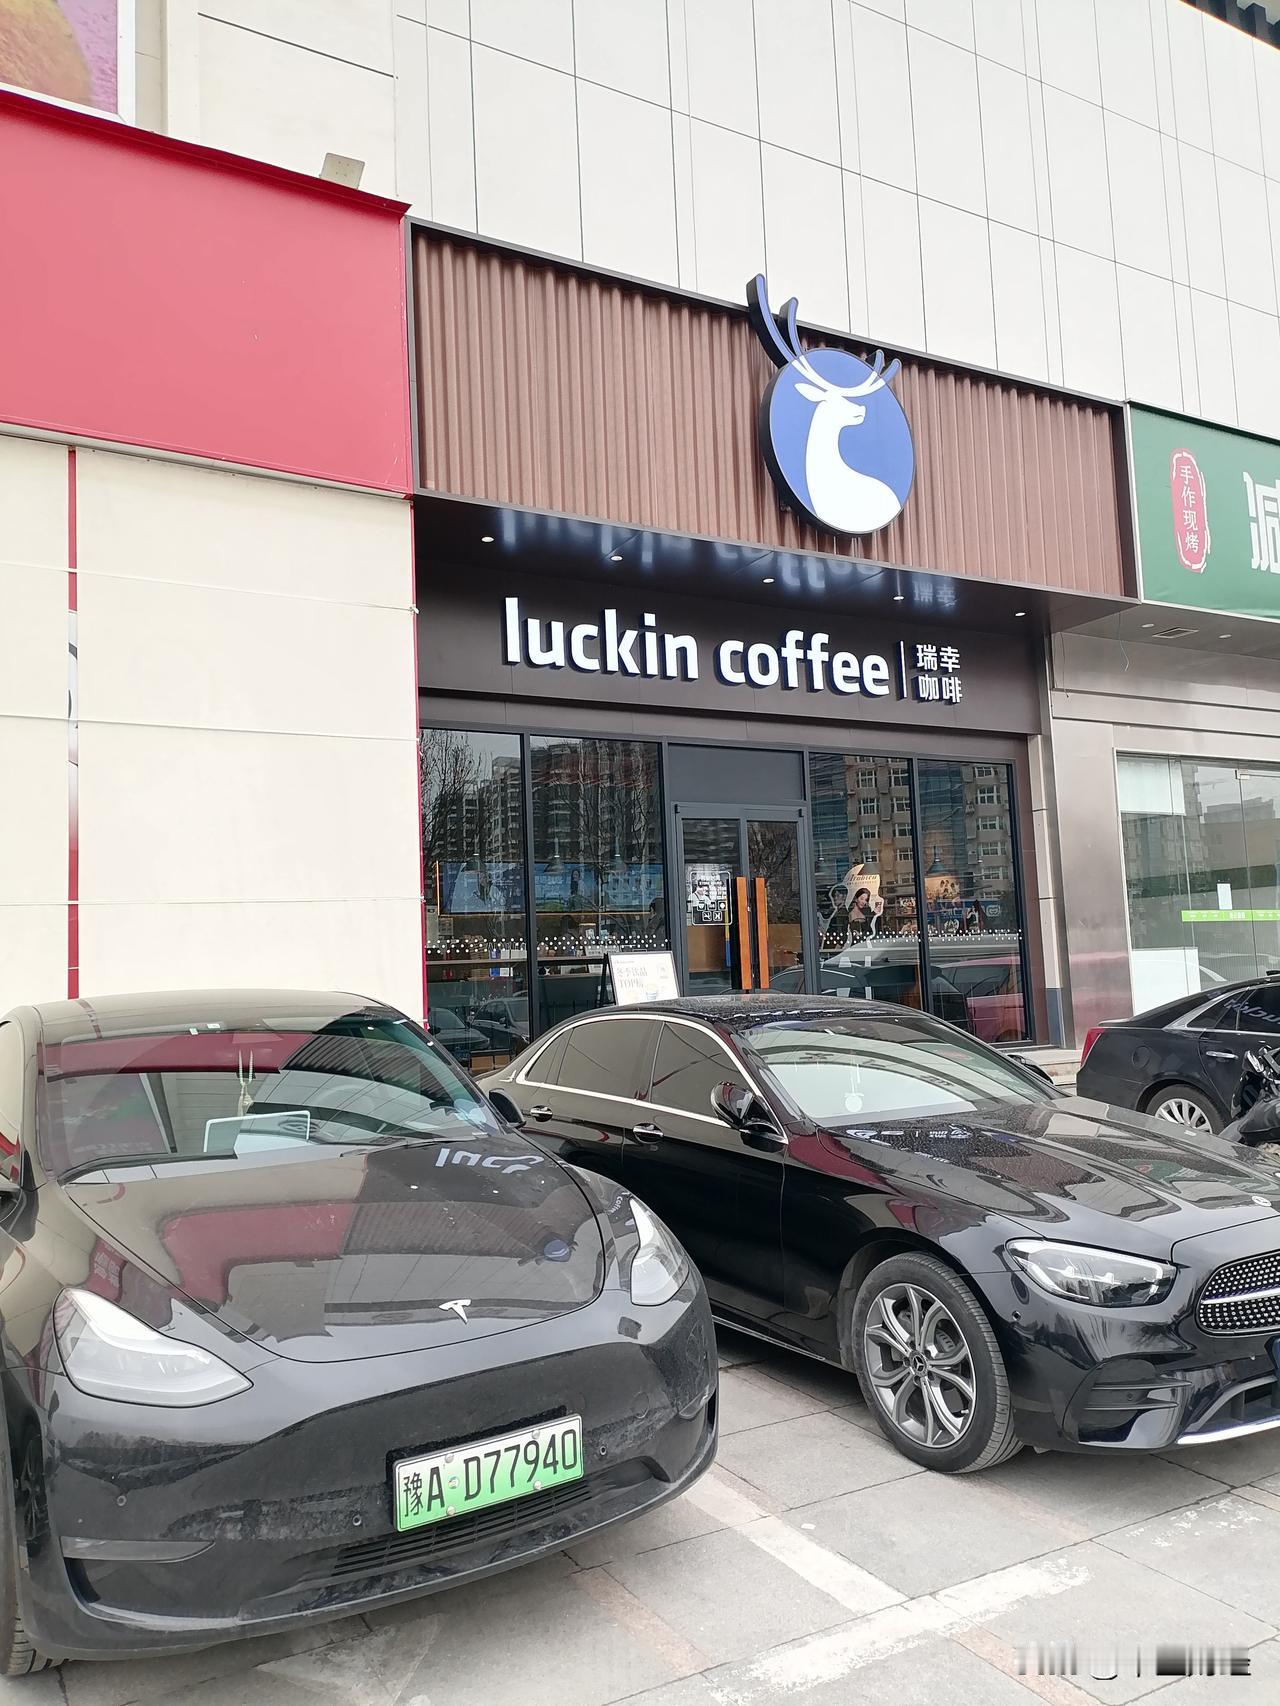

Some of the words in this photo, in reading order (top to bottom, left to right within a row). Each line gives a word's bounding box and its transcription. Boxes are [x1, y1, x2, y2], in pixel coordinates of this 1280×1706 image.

[1180, 465, 1199, 553] 手作现烤
[504, 597, 699, 681] luckin
[716, 630, 890, 697] coffee
[915, 644, 961, 672] 瑞幸
[917, 675, 963, 703] 咖啡
